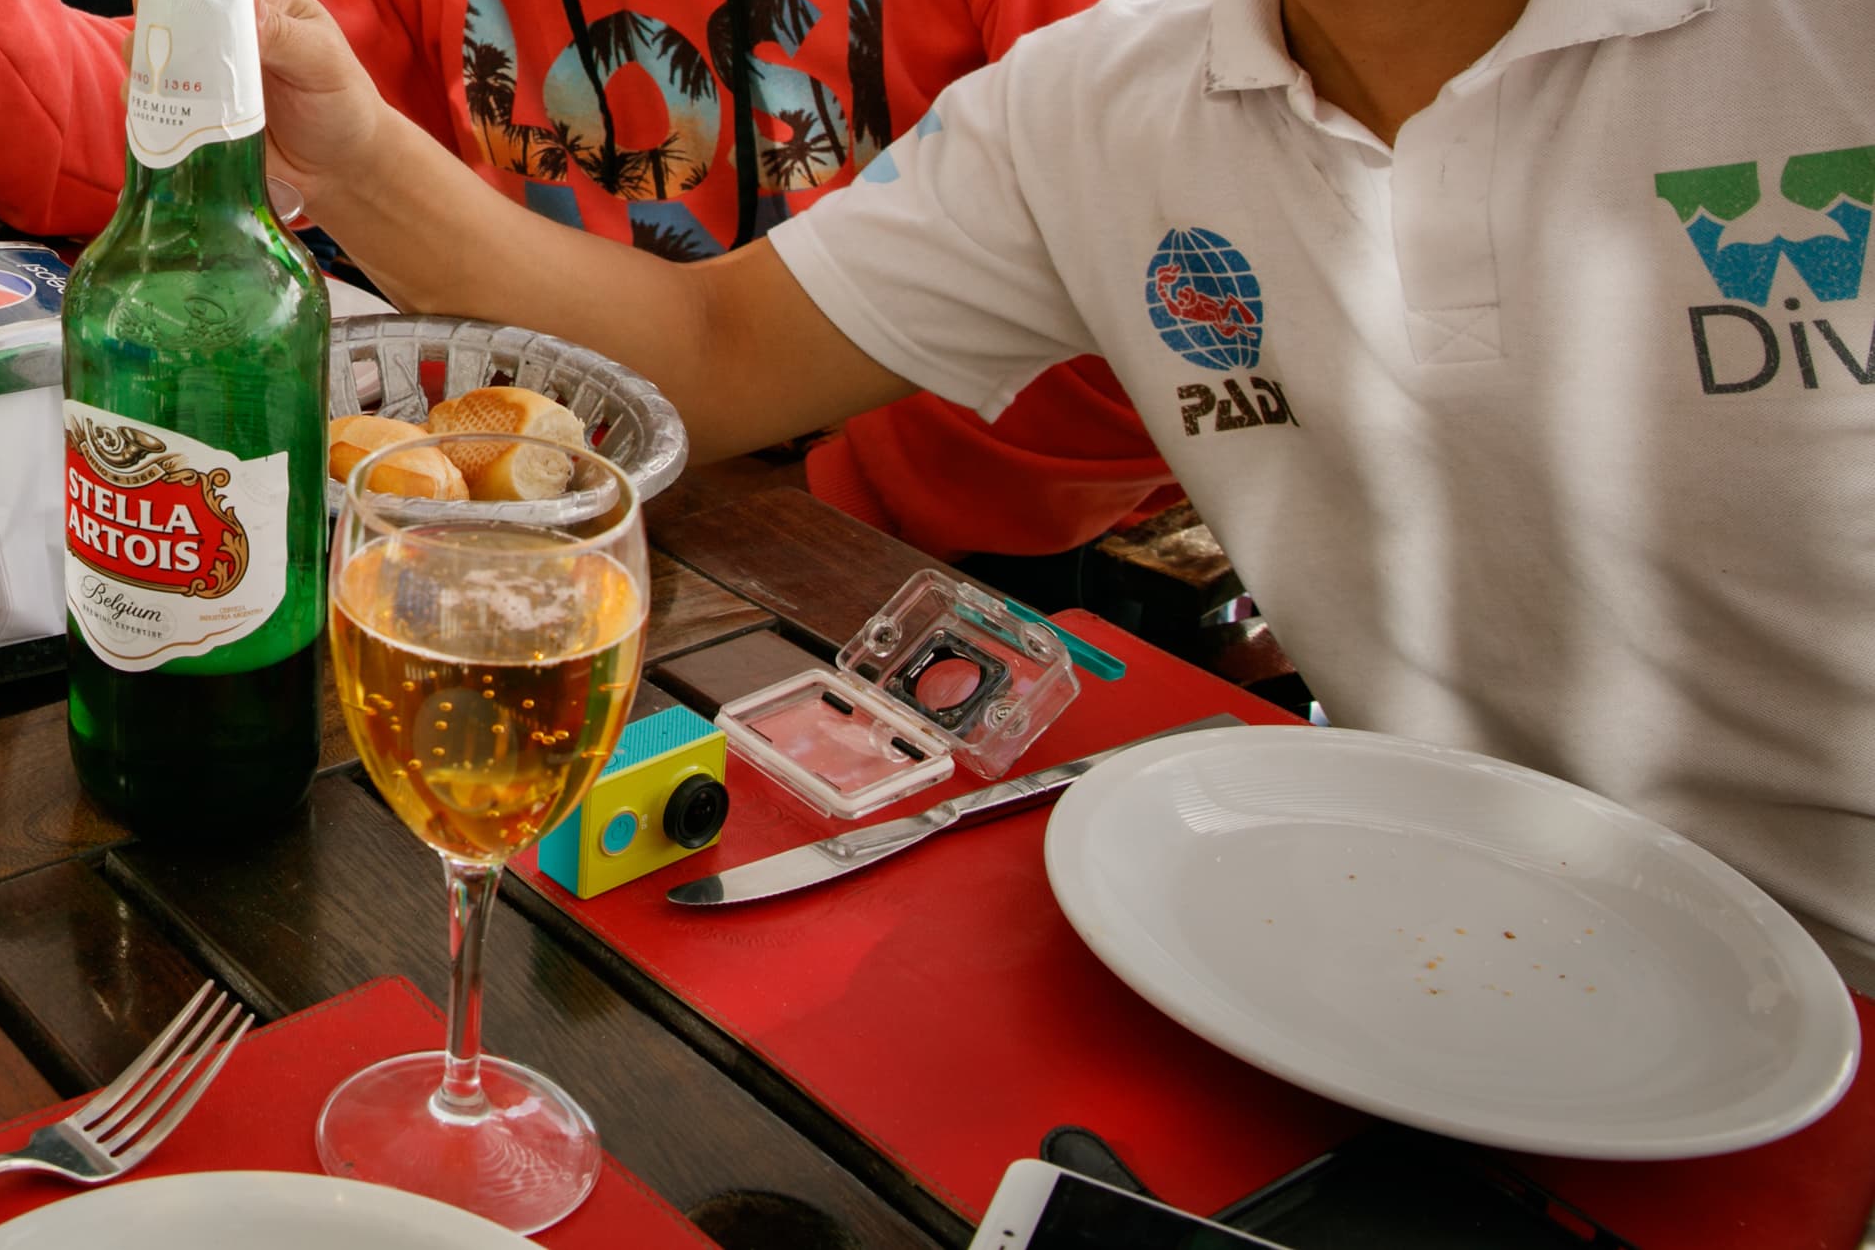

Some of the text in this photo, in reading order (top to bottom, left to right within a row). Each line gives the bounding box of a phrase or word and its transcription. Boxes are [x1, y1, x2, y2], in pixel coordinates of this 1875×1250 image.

[164, 79, 203, 93] 1366
[132, 96, 192, 117] PREMIUM
[16, 263, 66, 294] epsi
[1176, 376, 1300, 436] PADI
[126, 469, 156, 485] 1366
[68, 466, 200, 535] STELLA
[68, 503, 201, 572] ARTOIS
[80, 574, 164, 624] Belgium
[115, 622, 164, 639] EXPERTISE
